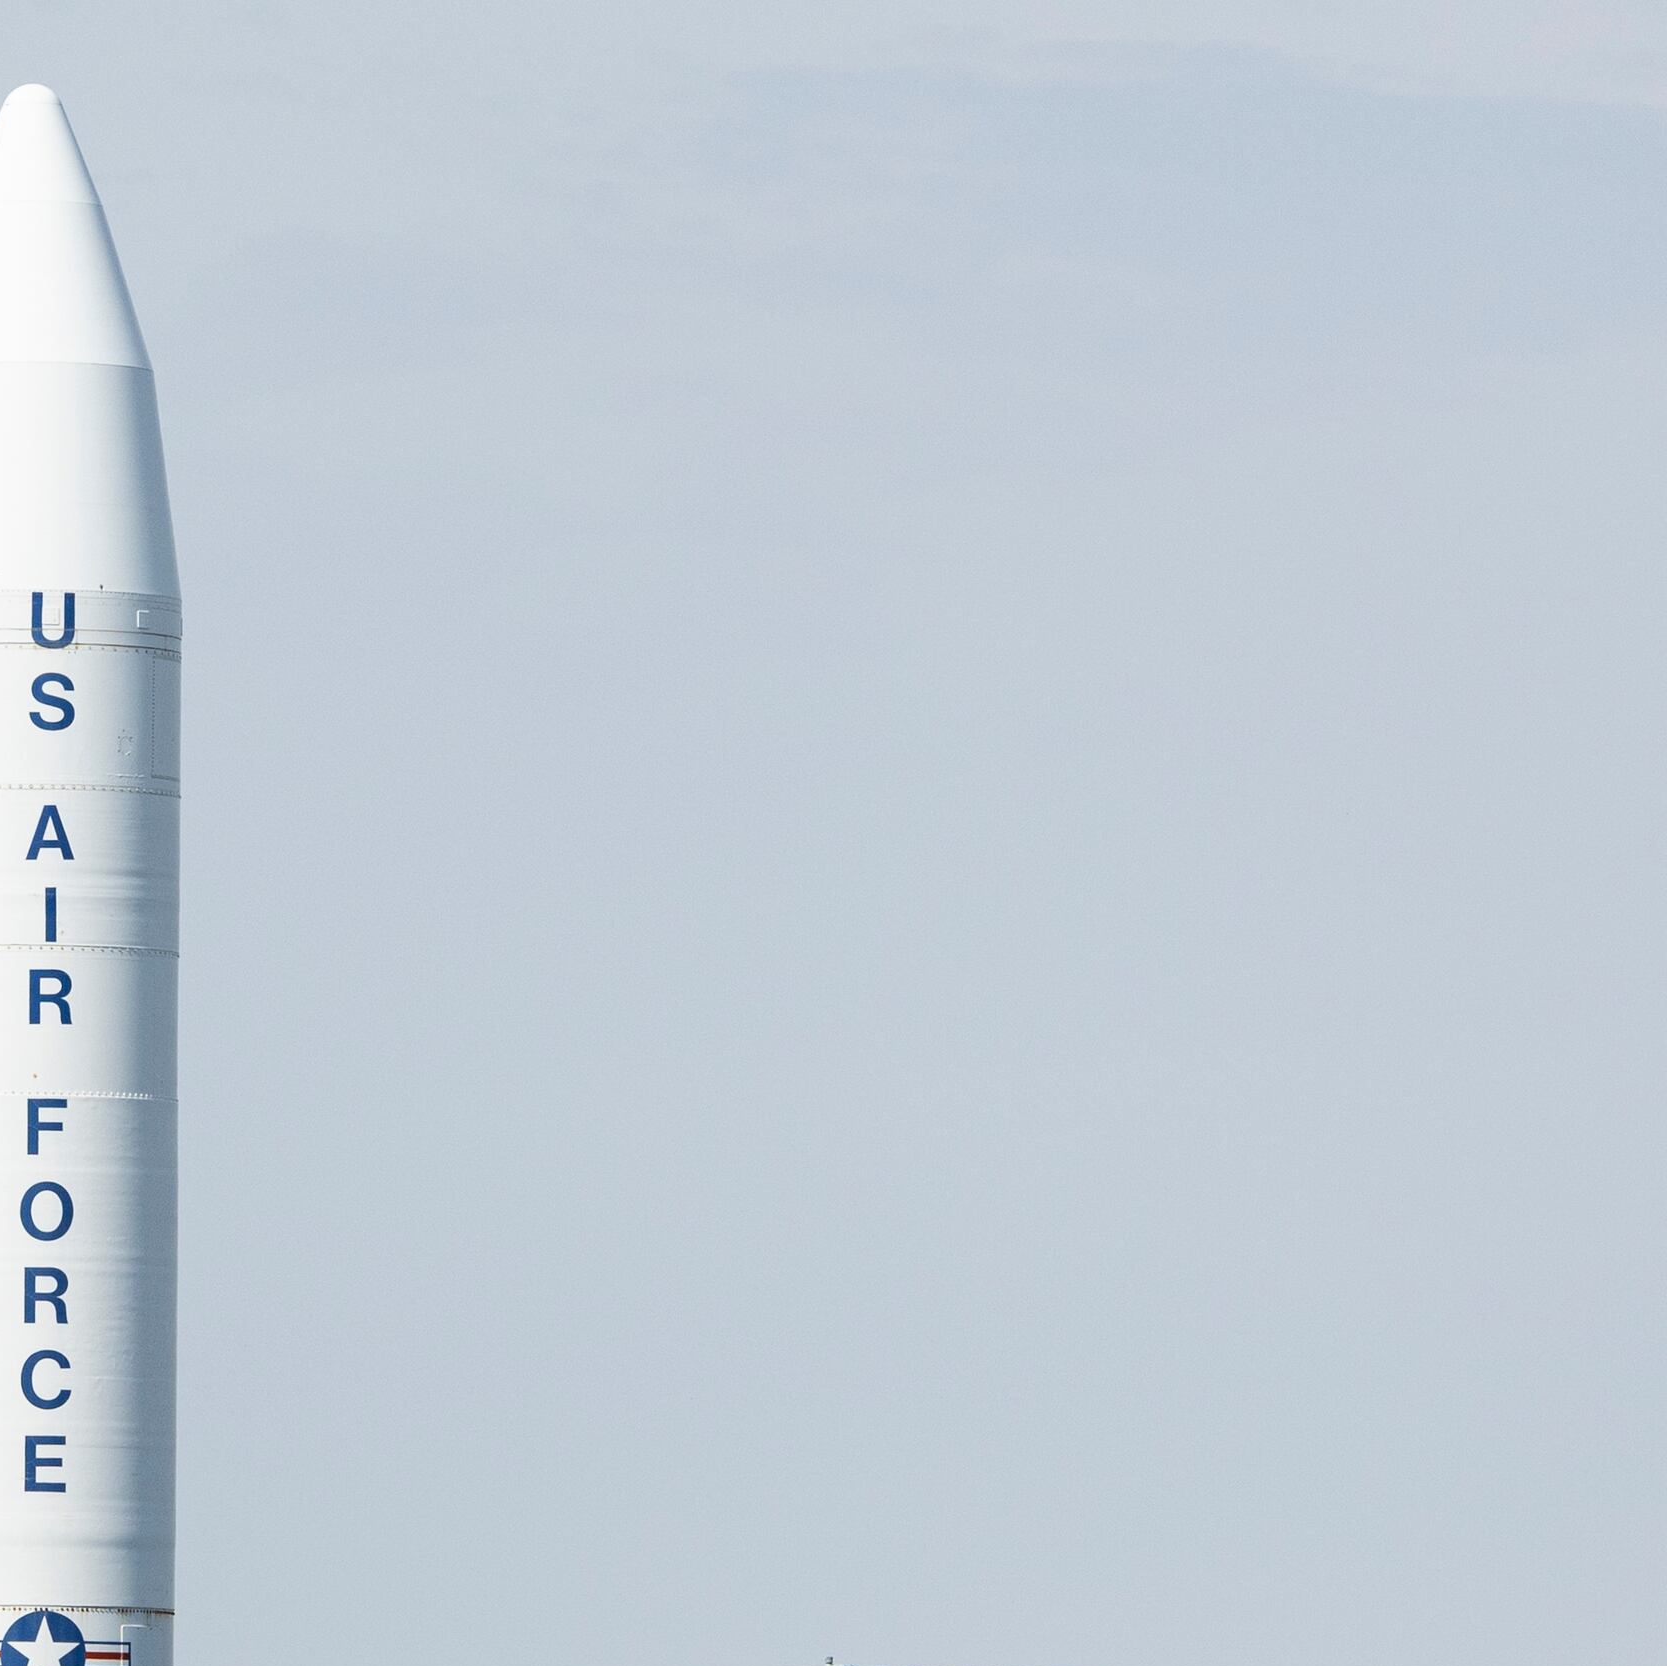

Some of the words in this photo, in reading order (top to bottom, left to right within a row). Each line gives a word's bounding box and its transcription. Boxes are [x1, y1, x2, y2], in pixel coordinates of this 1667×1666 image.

[29, 592, 76, 731] US
[26, 804, 75, 1025] AIR
[19, 1098, 74, 1492] FORCE
